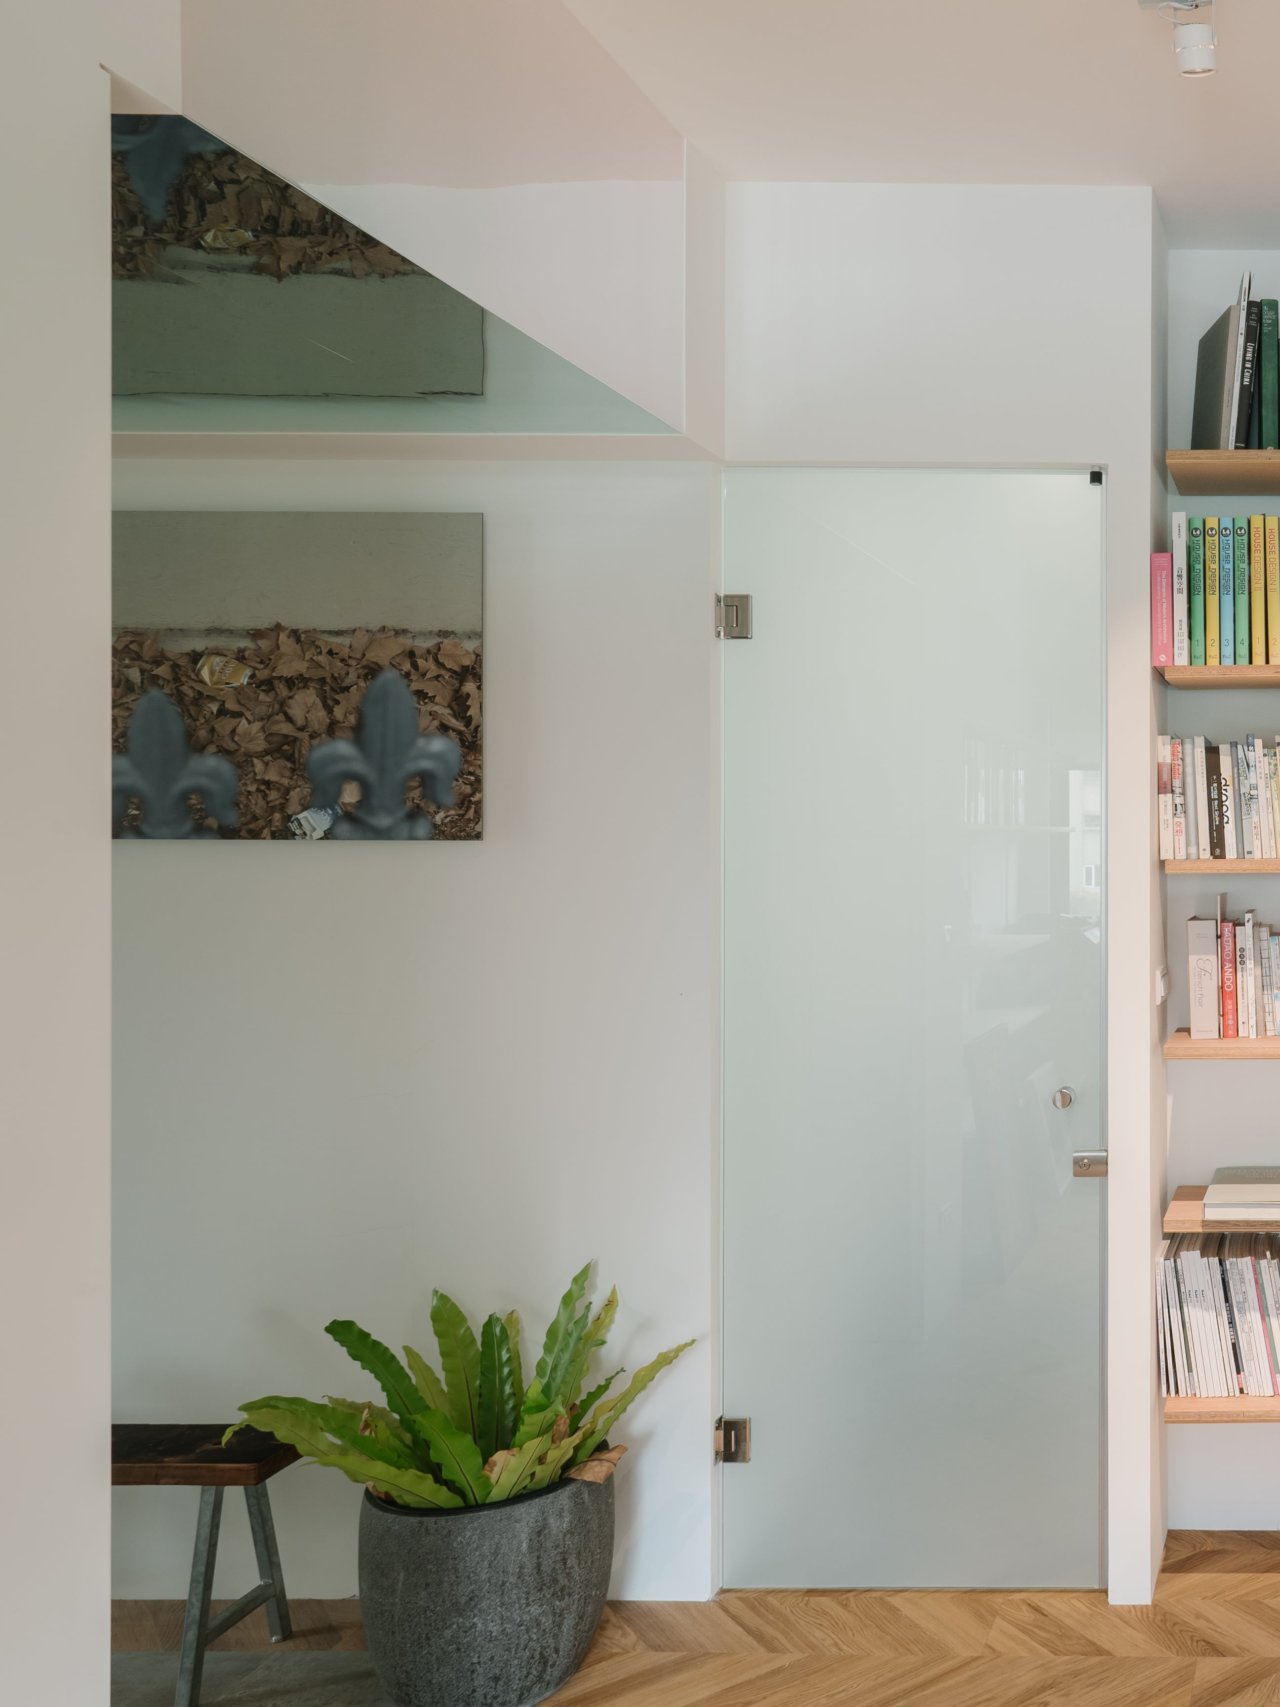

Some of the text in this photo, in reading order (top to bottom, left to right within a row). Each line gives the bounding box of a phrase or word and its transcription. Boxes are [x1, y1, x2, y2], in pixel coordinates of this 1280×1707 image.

[1254, 527, 1262, 554] HOUSE
[1268, 528, 1276, 555] HOUSE
[1254, 556, 1262, 584] DESIGN
[1269, 557, 1277, 585] DESIGN
[1210, 639, 1215, 647] 2
[1224, 639, 1229, 647] 3
[1239, 638, 1244, 646] 4
[1223, 925, 1232, 960] TADAO
[1224, 962, 1233, 991] ANDO
